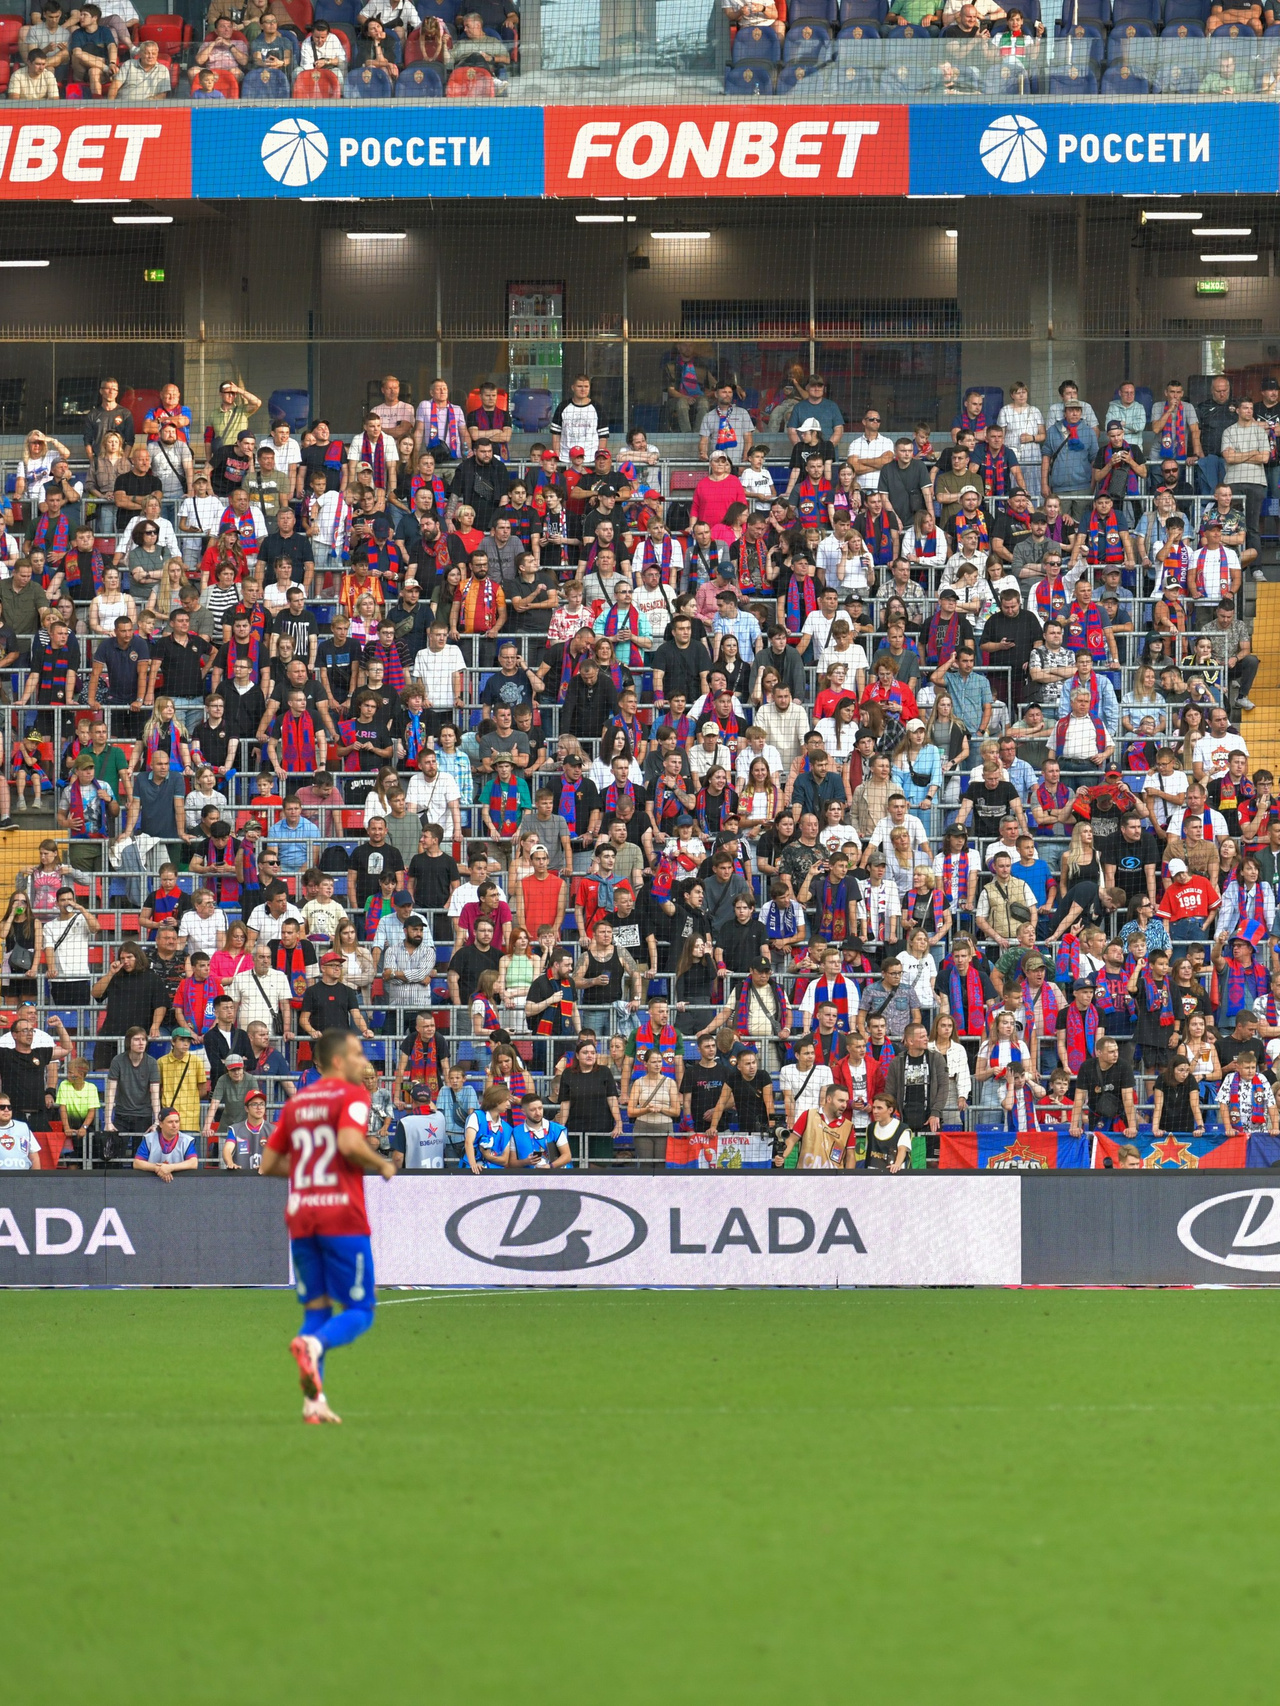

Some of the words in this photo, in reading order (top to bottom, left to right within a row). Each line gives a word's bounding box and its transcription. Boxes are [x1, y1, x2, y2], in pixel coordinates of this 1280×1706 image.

[0, 124, 162, 182] BET
[340, 136, 491, 167] РОССЕТИ
[567, 120, 880, 180] FONBET
[1058, 132, 1210, 163] РОССЕТИ
[1200, 282, 1225, 290] ВЫХОД
[291, 1124, 338, 1189] 22
[721, 1137, 750, 1146] ЦВЕТА
[669, 1207, 868, 1254] LADA
